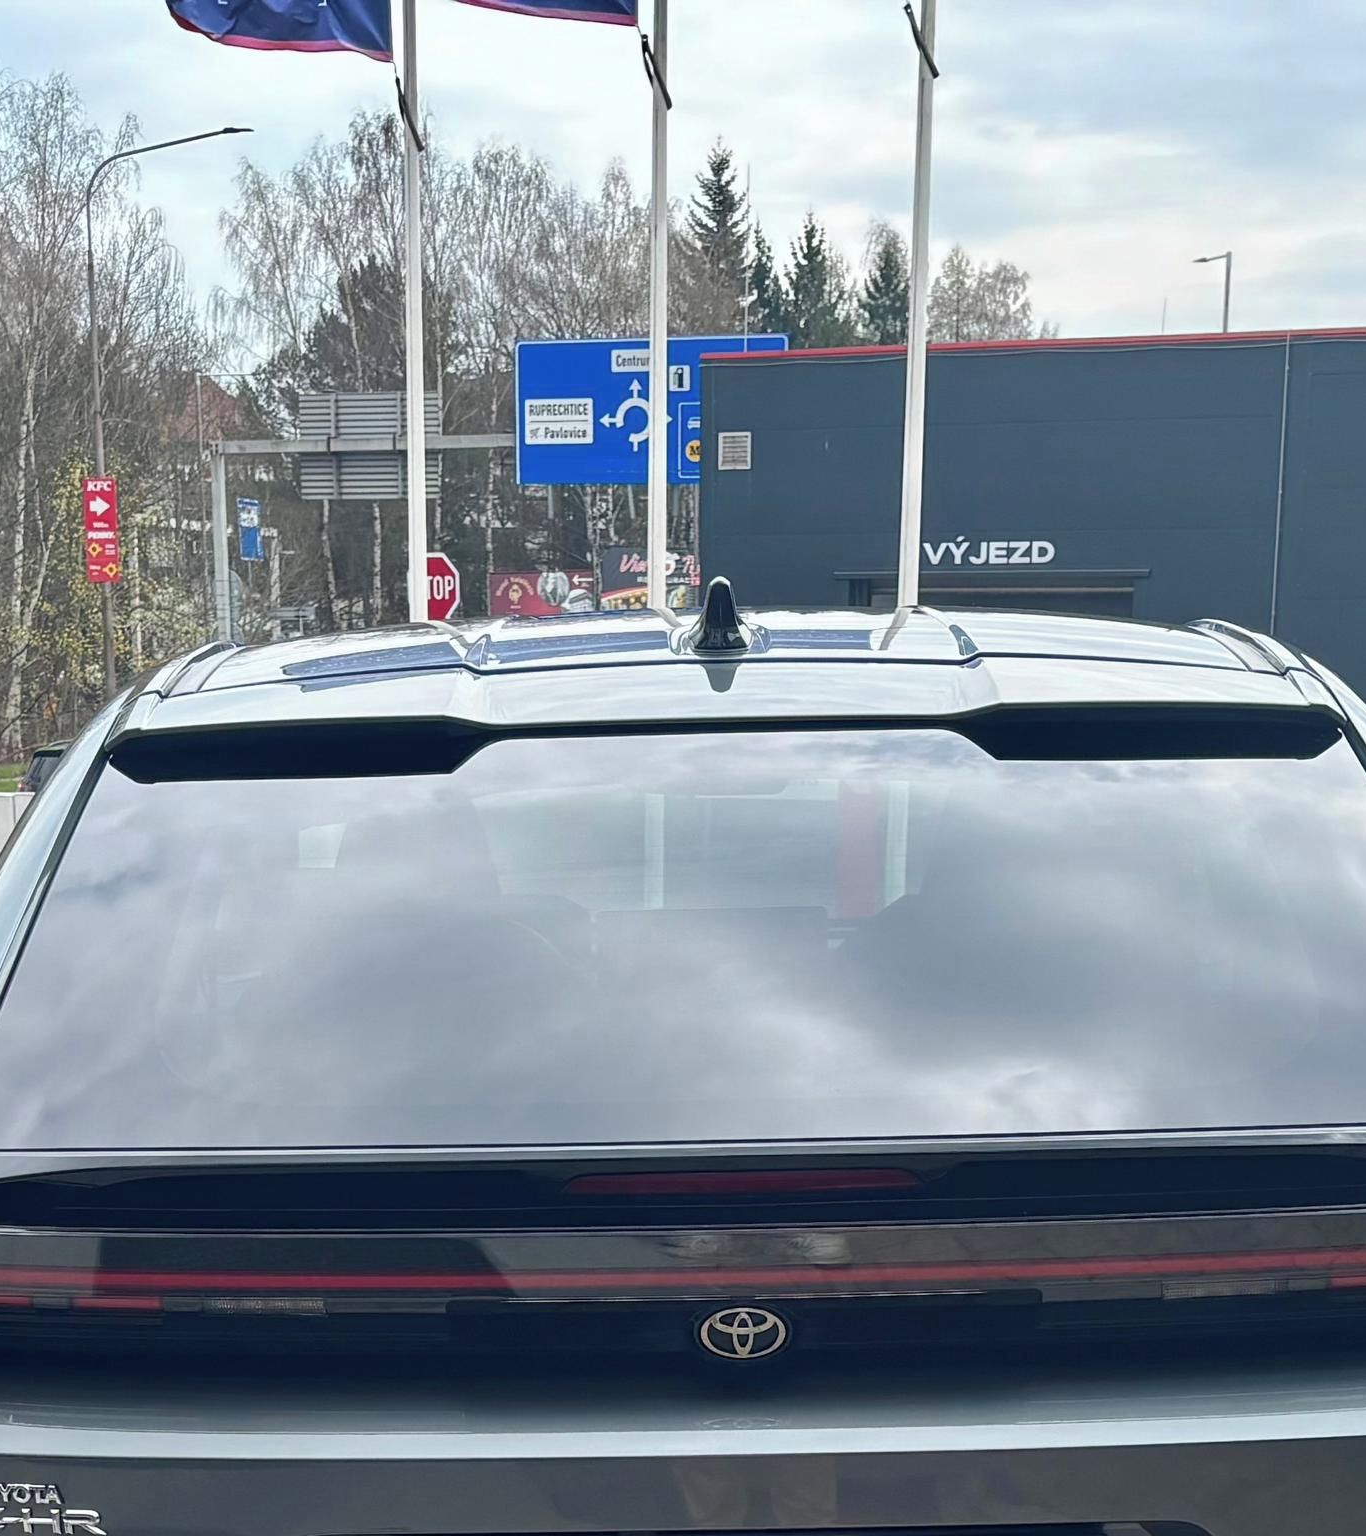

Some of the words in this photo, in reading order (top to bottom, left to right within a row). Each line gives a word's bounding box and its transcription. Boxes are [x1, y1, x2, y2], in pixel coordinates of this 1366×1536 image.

[616, 354, 650, 367] Centru
[528, 403, 589, 417] RUPRECHTICE
[86, 481, 112, 492] KFC
[922, 535, 1056, 565] VÝJEZD
[426, 575, 455, 601] TOP
